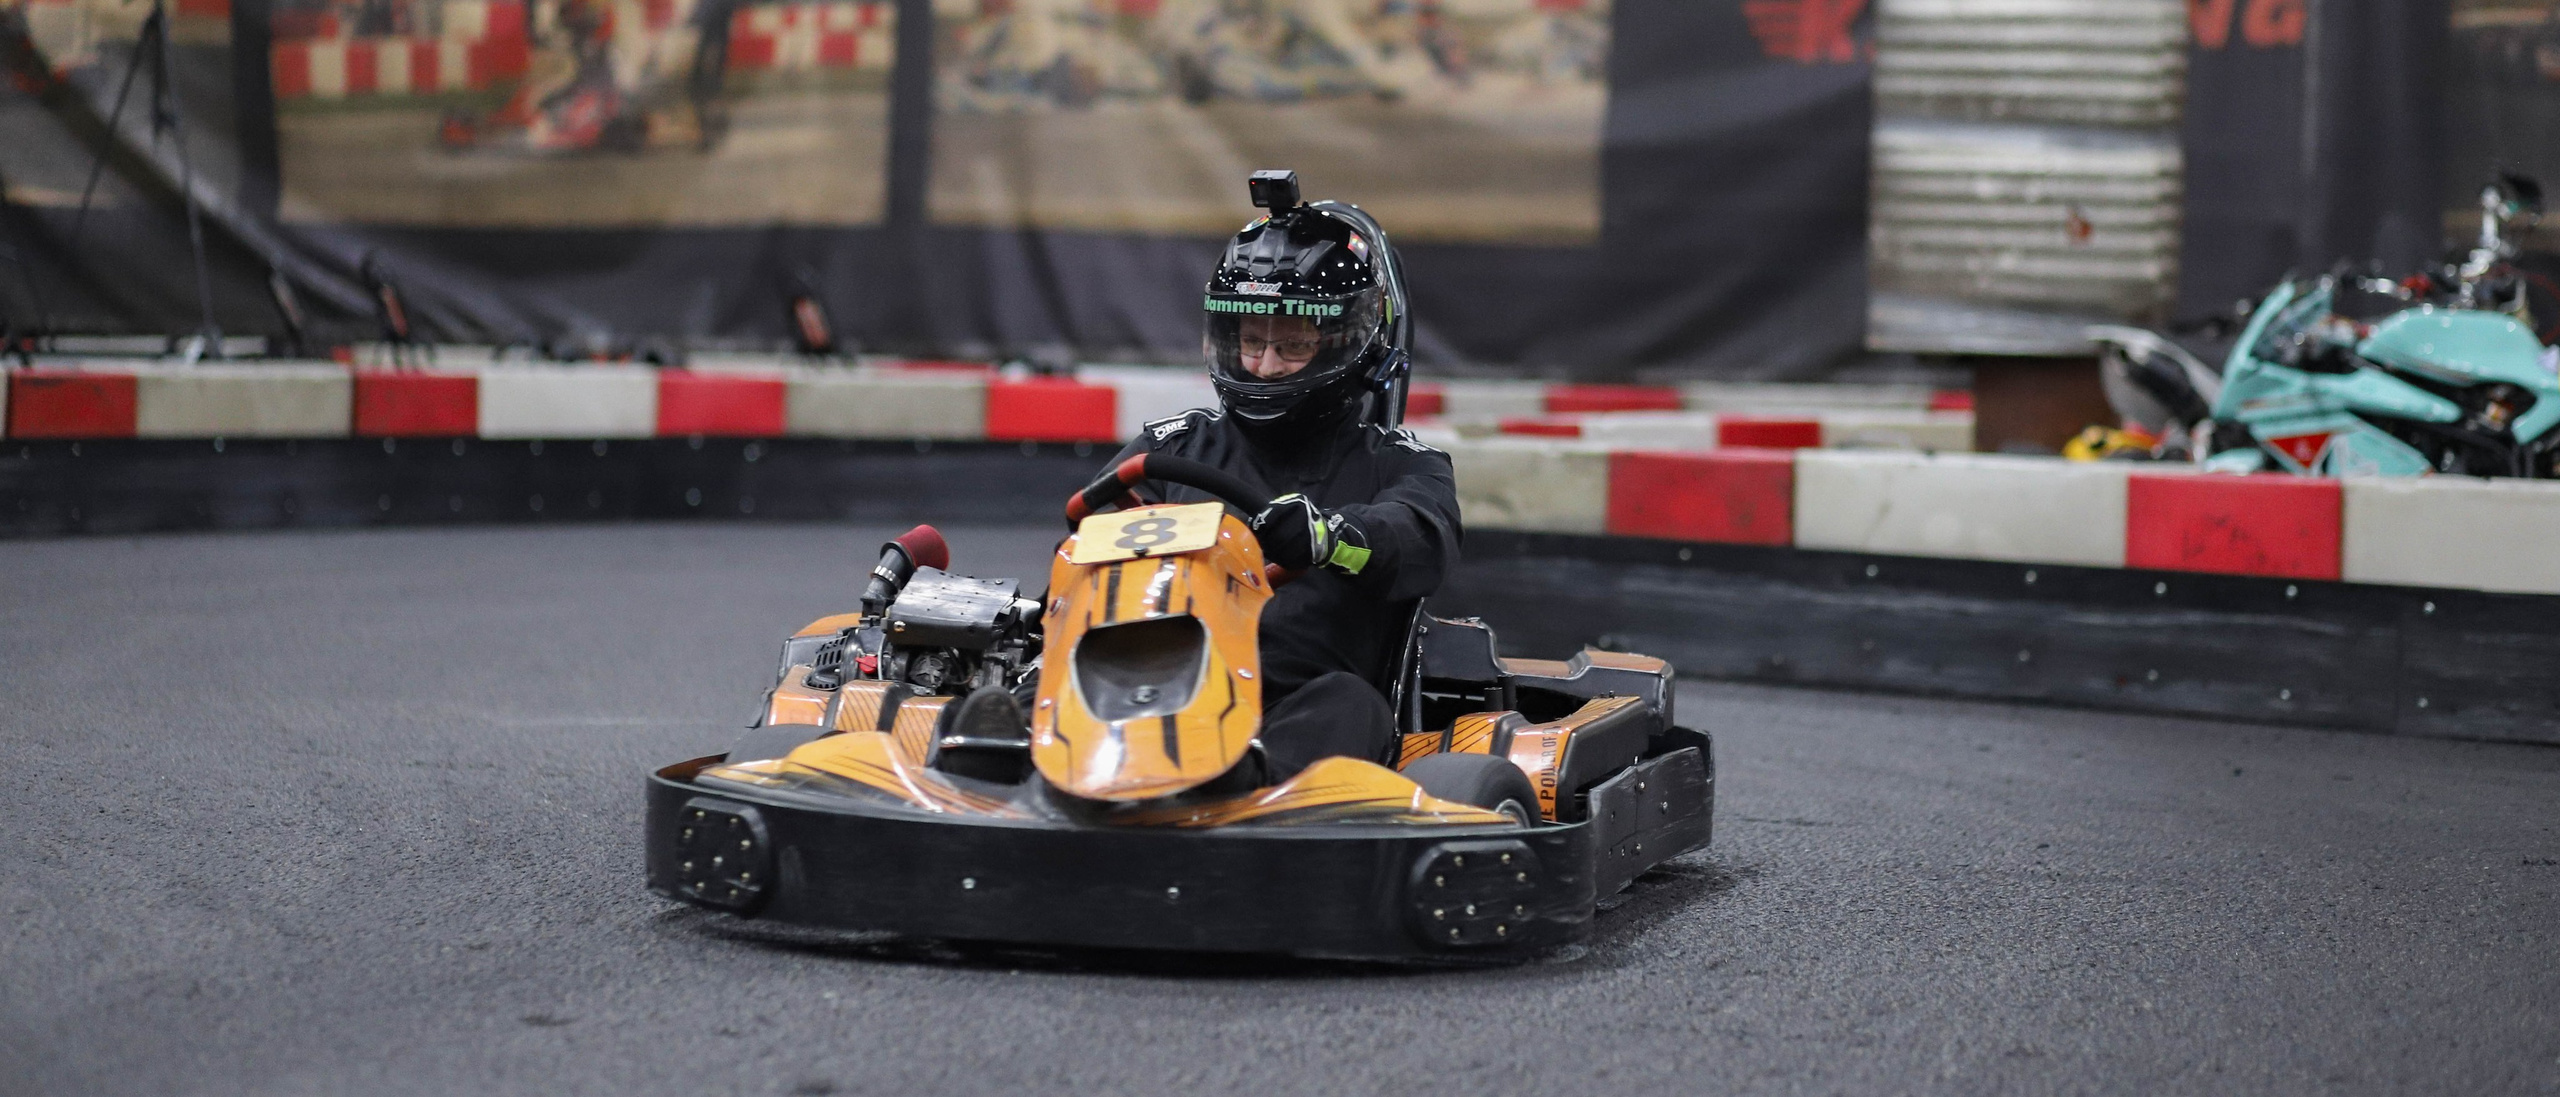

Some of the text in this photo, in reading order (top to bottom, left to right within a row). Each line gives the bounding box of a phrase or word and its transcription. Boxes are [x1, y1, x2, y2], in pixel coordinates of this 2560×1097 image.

[1204, 295, 1343, 317] Hammer Time
[1153, 419, 1187, 438] OMP
[1114, 517, 1178, 549] 8
